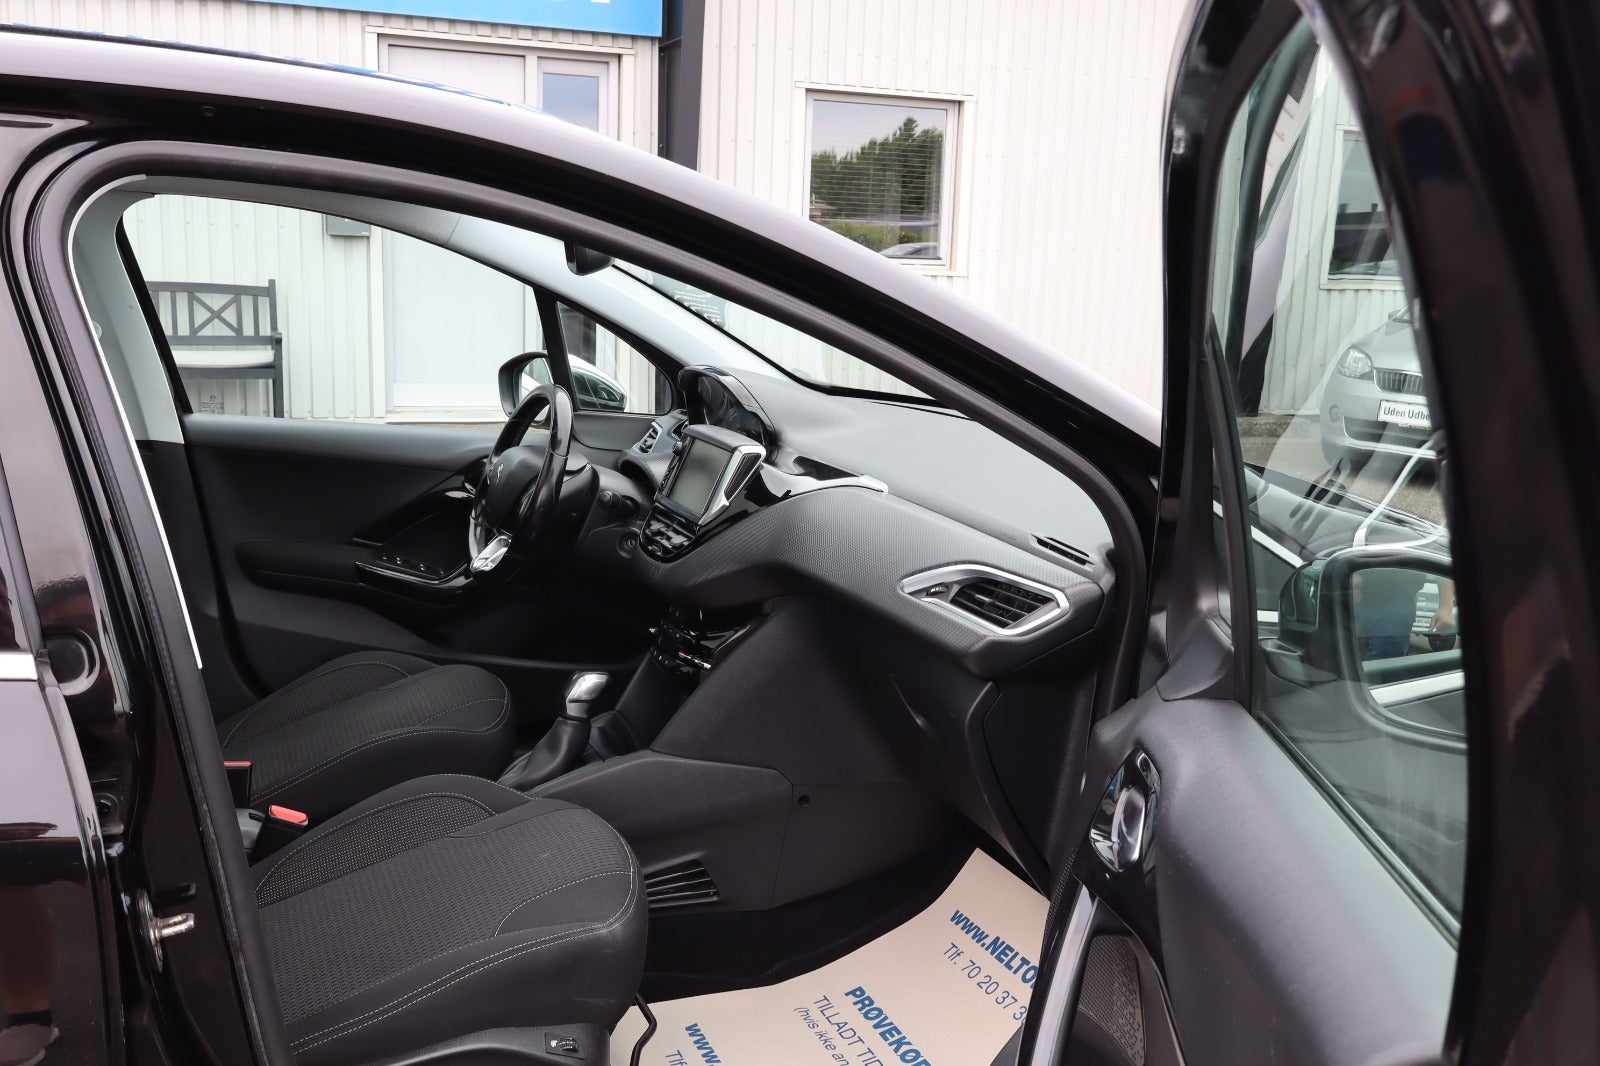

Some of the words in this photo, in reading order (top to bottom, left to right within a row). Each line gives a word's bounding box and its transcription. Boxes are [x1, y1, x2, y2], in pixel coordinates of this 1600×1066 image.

[1383, 406, 1406, 417] Uden
[950, 909, 1039, 989] www.NELTO
[944, 942, 965, 965] Tlf.
[961, 959, 982, 979] 70
[977, 974, 1000, 995] 20
[995, 990, 1018, 1009] 37
[1013, 1005, 1027, 1025] 3
[793, 1007, 819, 1029] (hvis
[815, 1030, 837, 1050] ikke
[813, 995, 865, 1046] TILLADT
